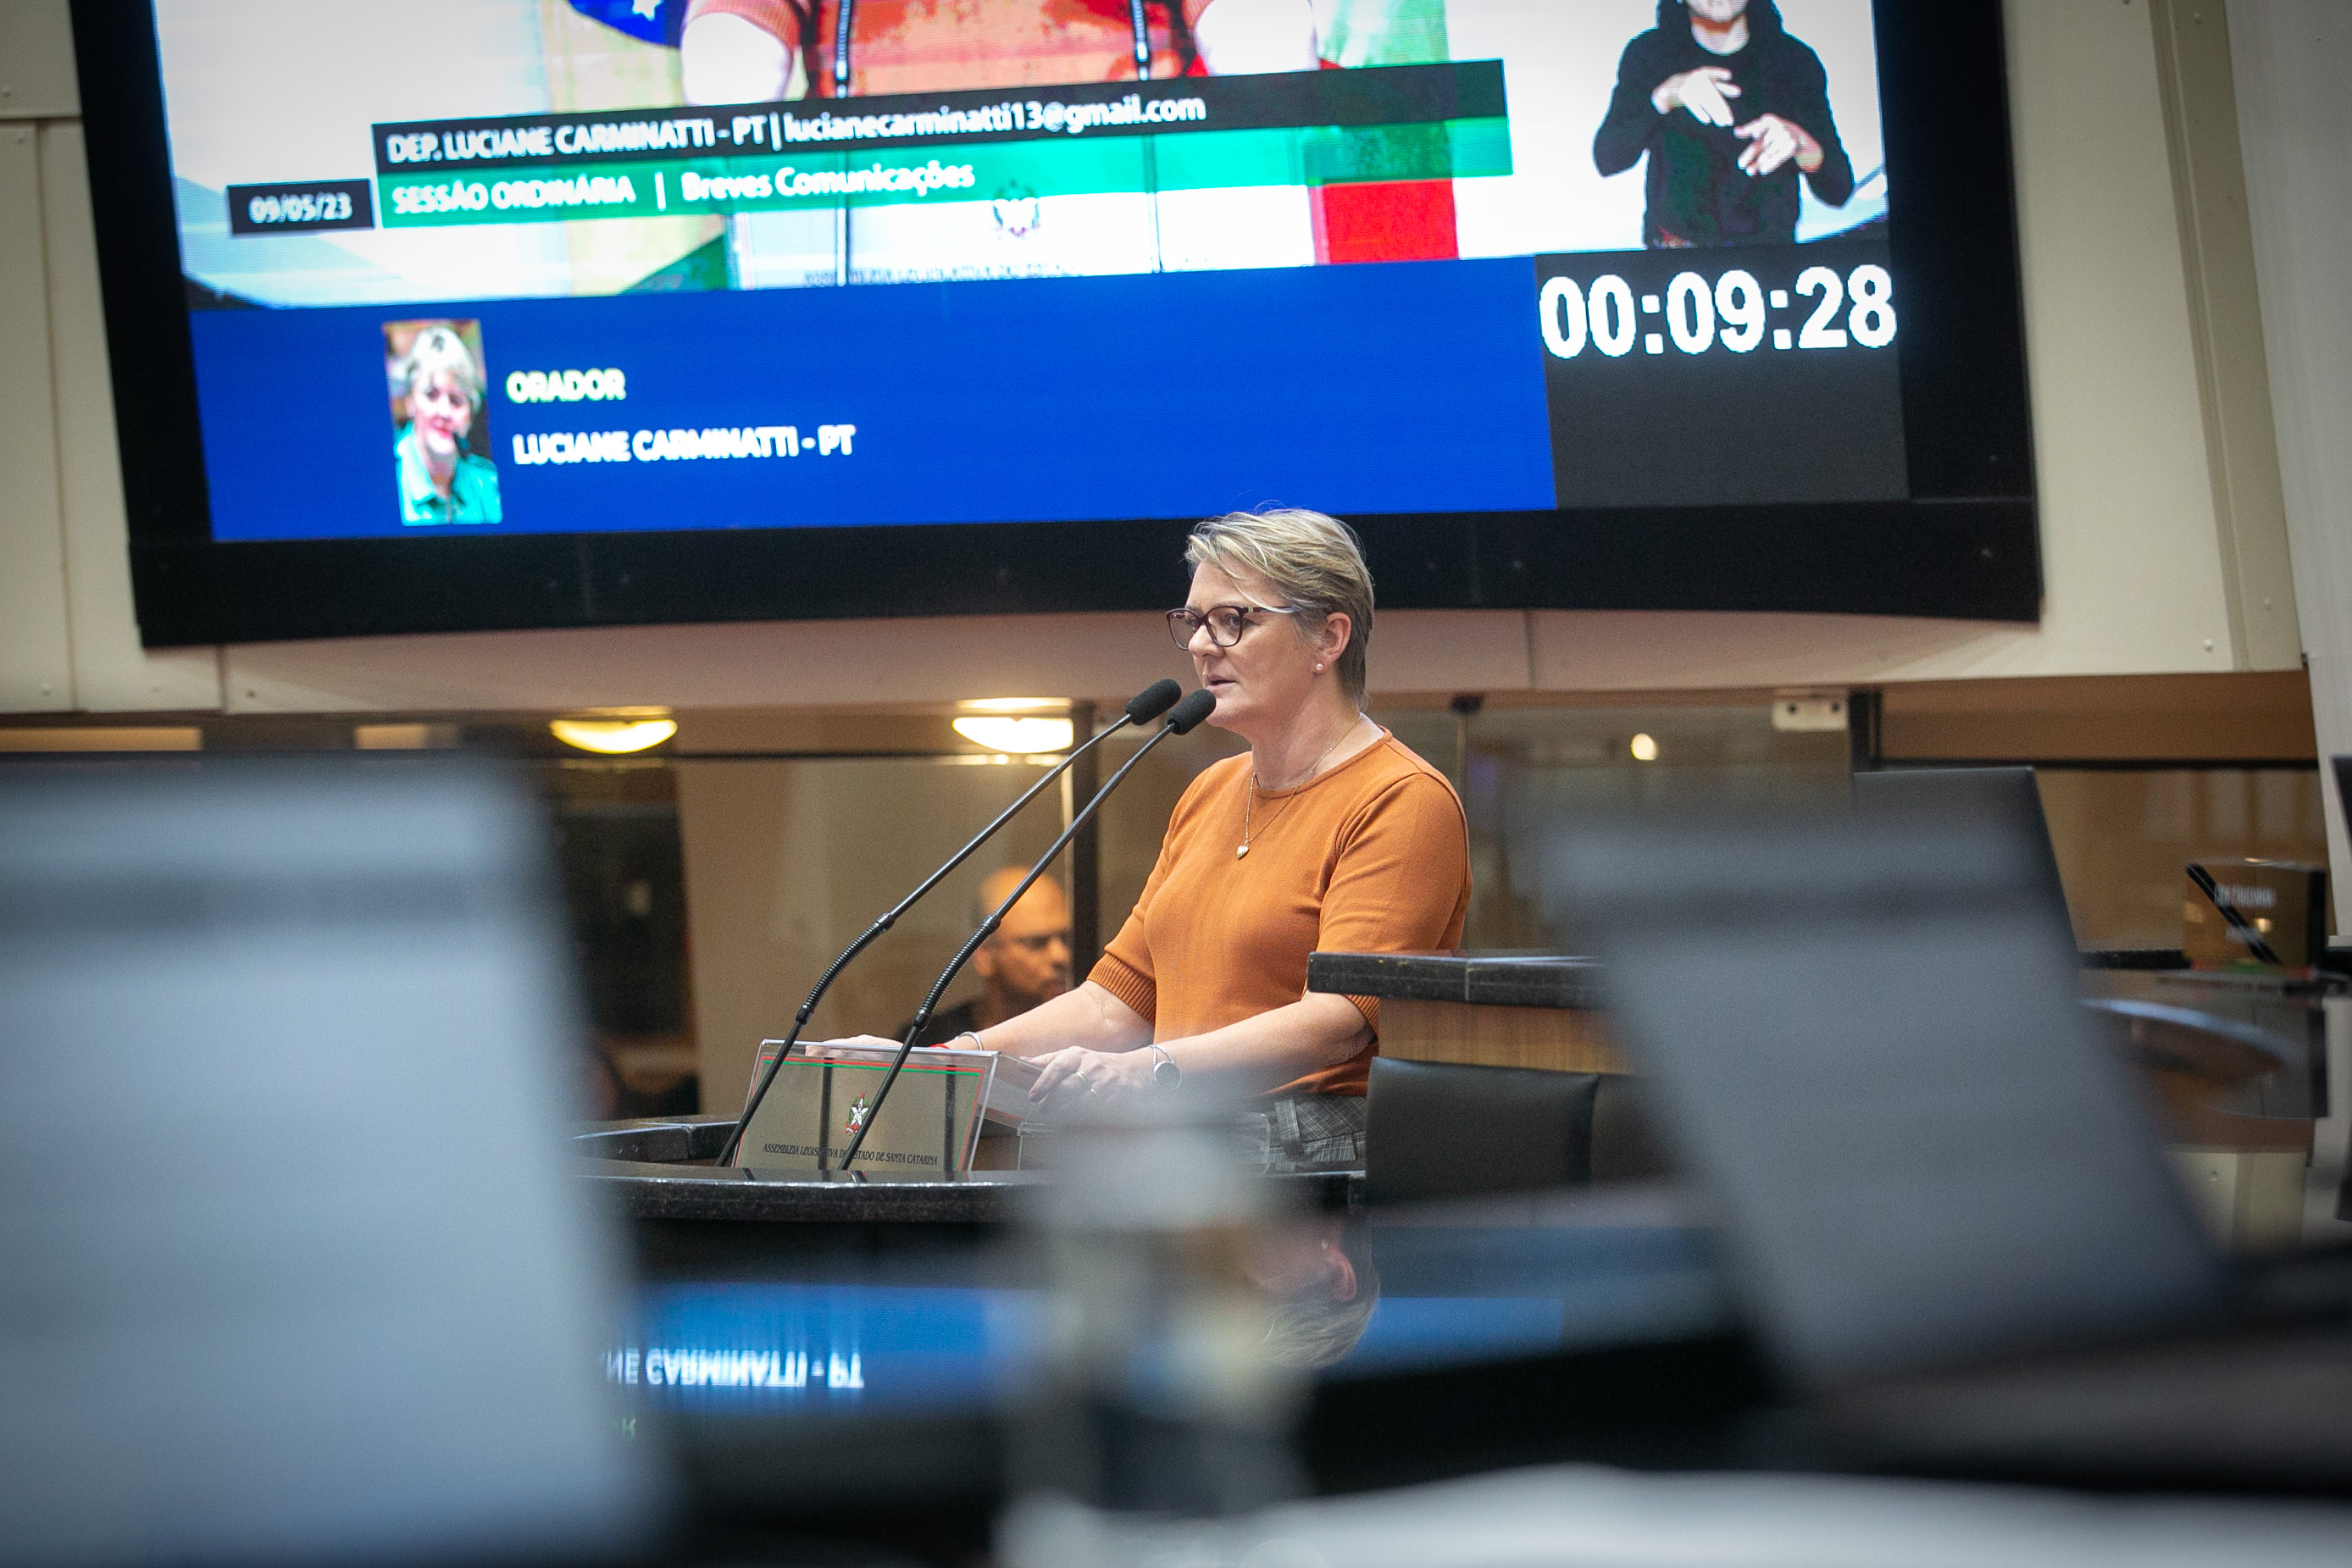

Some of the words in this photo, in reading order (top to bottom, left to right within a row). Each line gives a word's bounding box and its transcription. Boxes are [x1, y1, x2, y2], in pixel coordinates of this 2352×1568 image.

[386, 133, 441, 164] DEP.
[442, 126, 554, 160] LUCIANE
[556, 116, 716, 153] CARMINATTI
[732, 113, 766, 147] PT
[784, 93, 1207, 136] lucianecarminatti13@gmail.com
[391, 180, 489, 215] SESSÃO
[490, 173, 636, 211] ORDINÁRIA
[681, 168, 773, 203] Breves
[774, 158, 976, 198] Comunicações
[247, 191, 353, 225] 09/05/23
[1539, 264, 1898, 359] 00:09:28
[506, 368, 626, 403] ORADOR
[512, 431, 630, 465] LUCIANE
[631, 426, 800, 463] CARMINATTI
[818, 424, 857, 456] PT
[762, 1143, 799, 1155] ASSEMBLEIA
[852, 1151, 874, 1161] STADO
[875, 1152, 885, 1162] DE
[886, 1154, 906, 1164] SANTA
[907, 1155, 938, 1166] CATARINA
